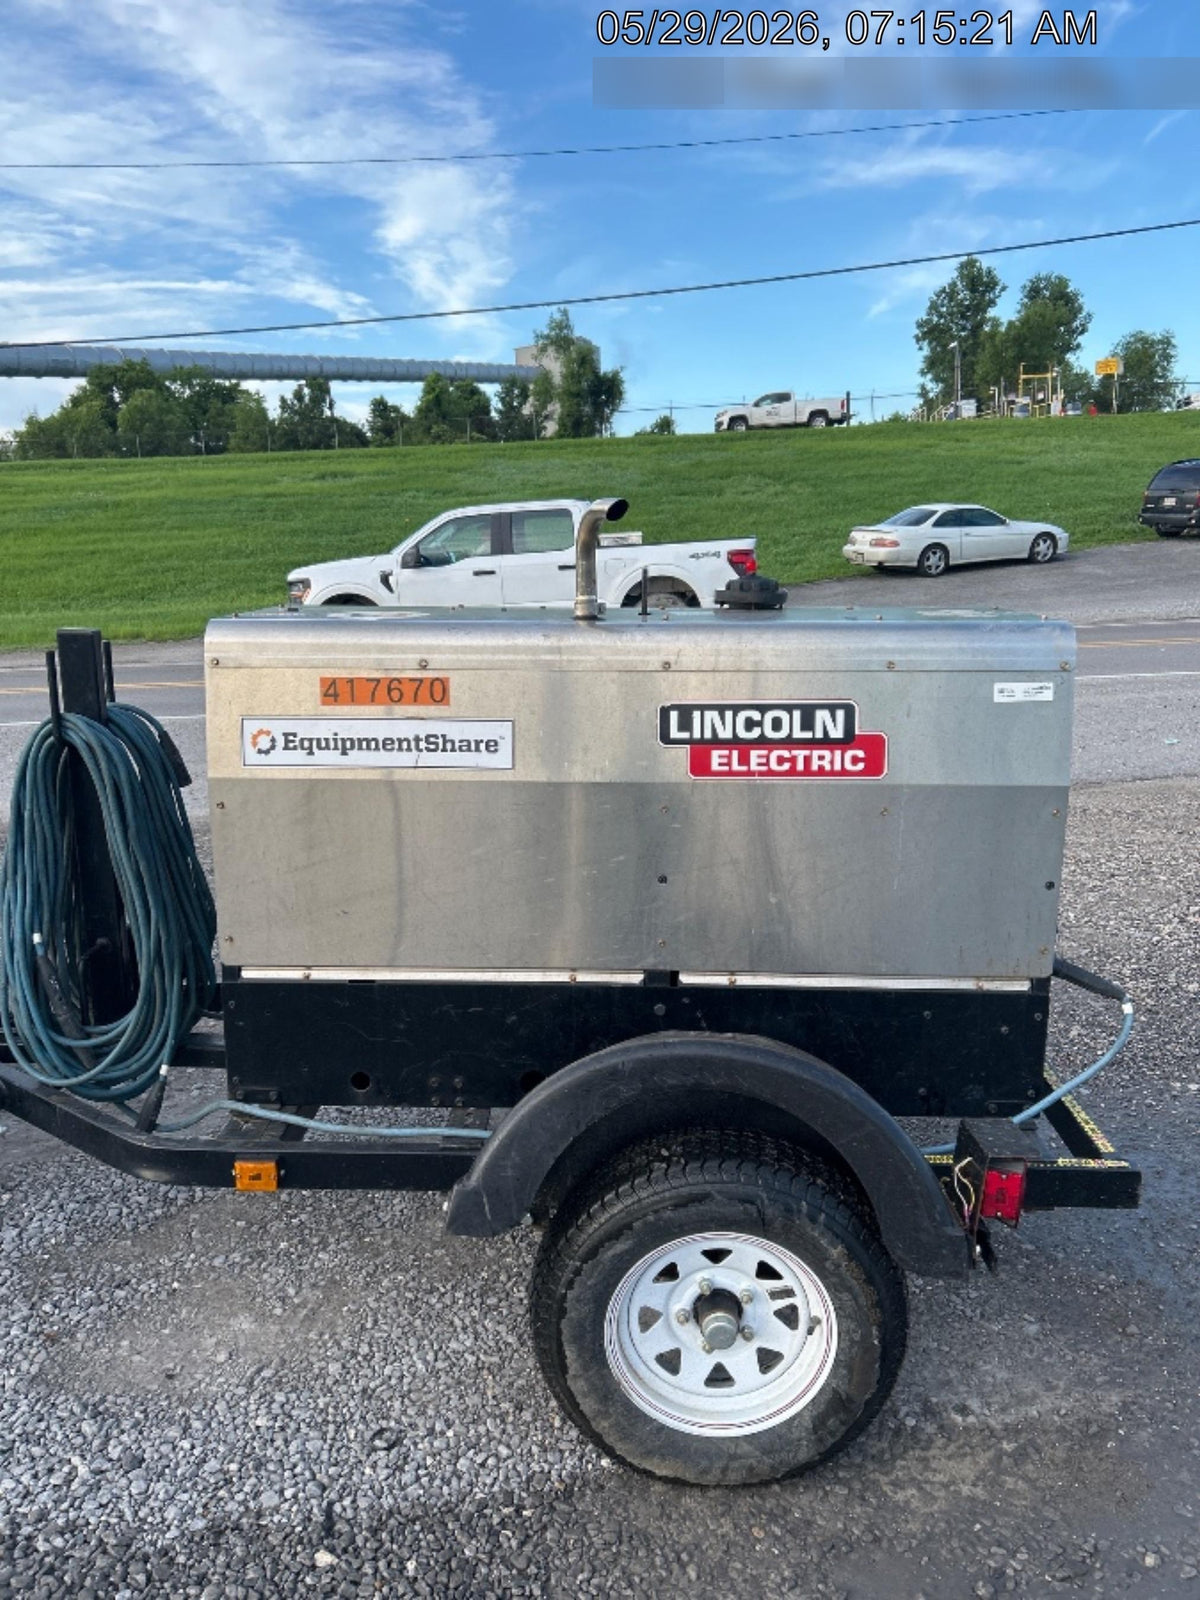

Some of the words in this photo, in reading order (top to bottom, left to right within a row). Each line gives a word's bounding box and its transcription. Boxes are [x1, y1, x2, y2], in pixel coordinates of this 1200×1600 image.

[323, 677, 447, 703] 417670
[669, 709, 845, 739] LINCOLN
[282, 732, 499, 756] EquipmentShare
[710, 749, 866, 773] ELECTRIC
